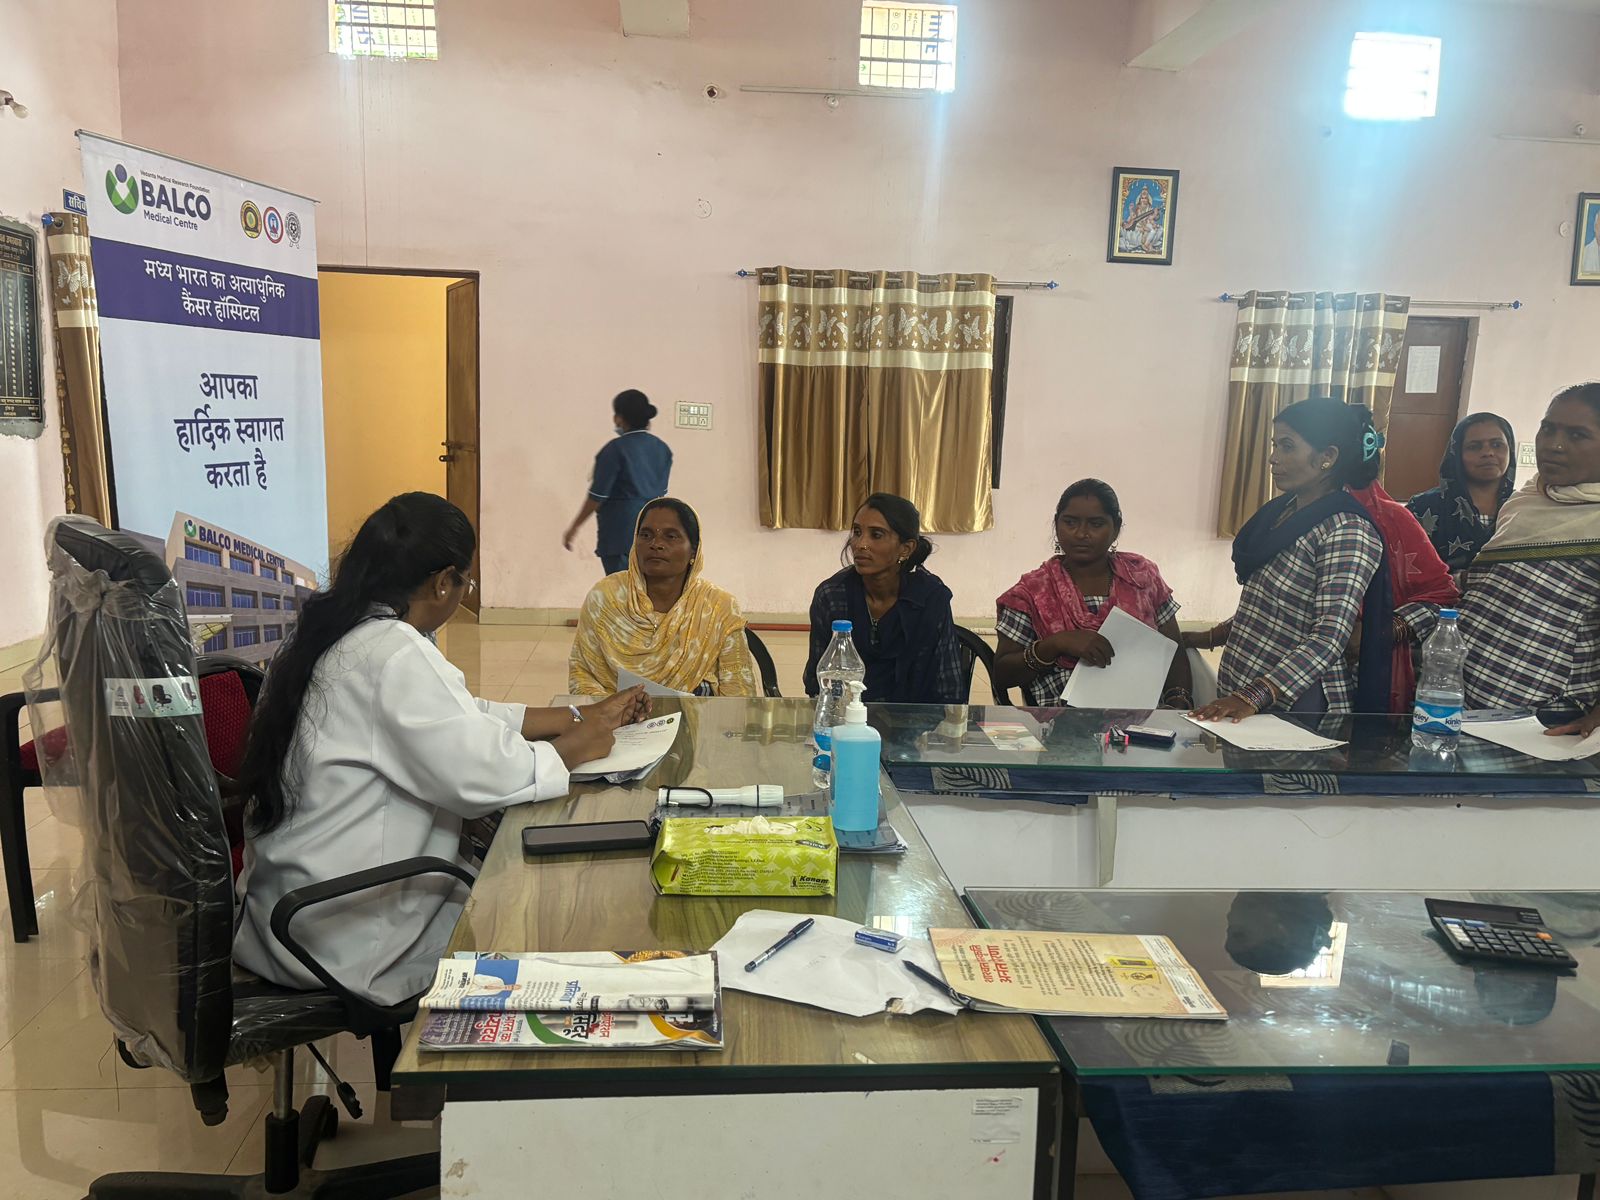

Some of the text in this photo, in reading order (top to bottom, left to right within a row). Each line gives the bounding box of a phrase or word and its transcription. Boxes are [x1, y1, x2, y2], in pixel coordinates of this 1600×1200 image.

[141, 179, 211, 221] BALCO
[157, 174, 172, 184] Medical
[172, 178, 190, 188] Research
[189, 183, 211, 194] Foundation
[143, 209, 199, 231] Medical Centre
[144, 259, 286, 303] मध्य भारत का अत्याधुनिक
[181, 287, 260, 322] कैंसर हॉस्पिटल
[199, 372, 258, 400] आपका
[173, 403, 284, 453] हार्दिक स्वागत
[204, 448, 267, 490] करता है
[199, 525, 286, 569] BALCO MEDICAL CENTRE
[800, 875, 829, 884] Kanam
[992, 962, 1013, 984] अनंत
